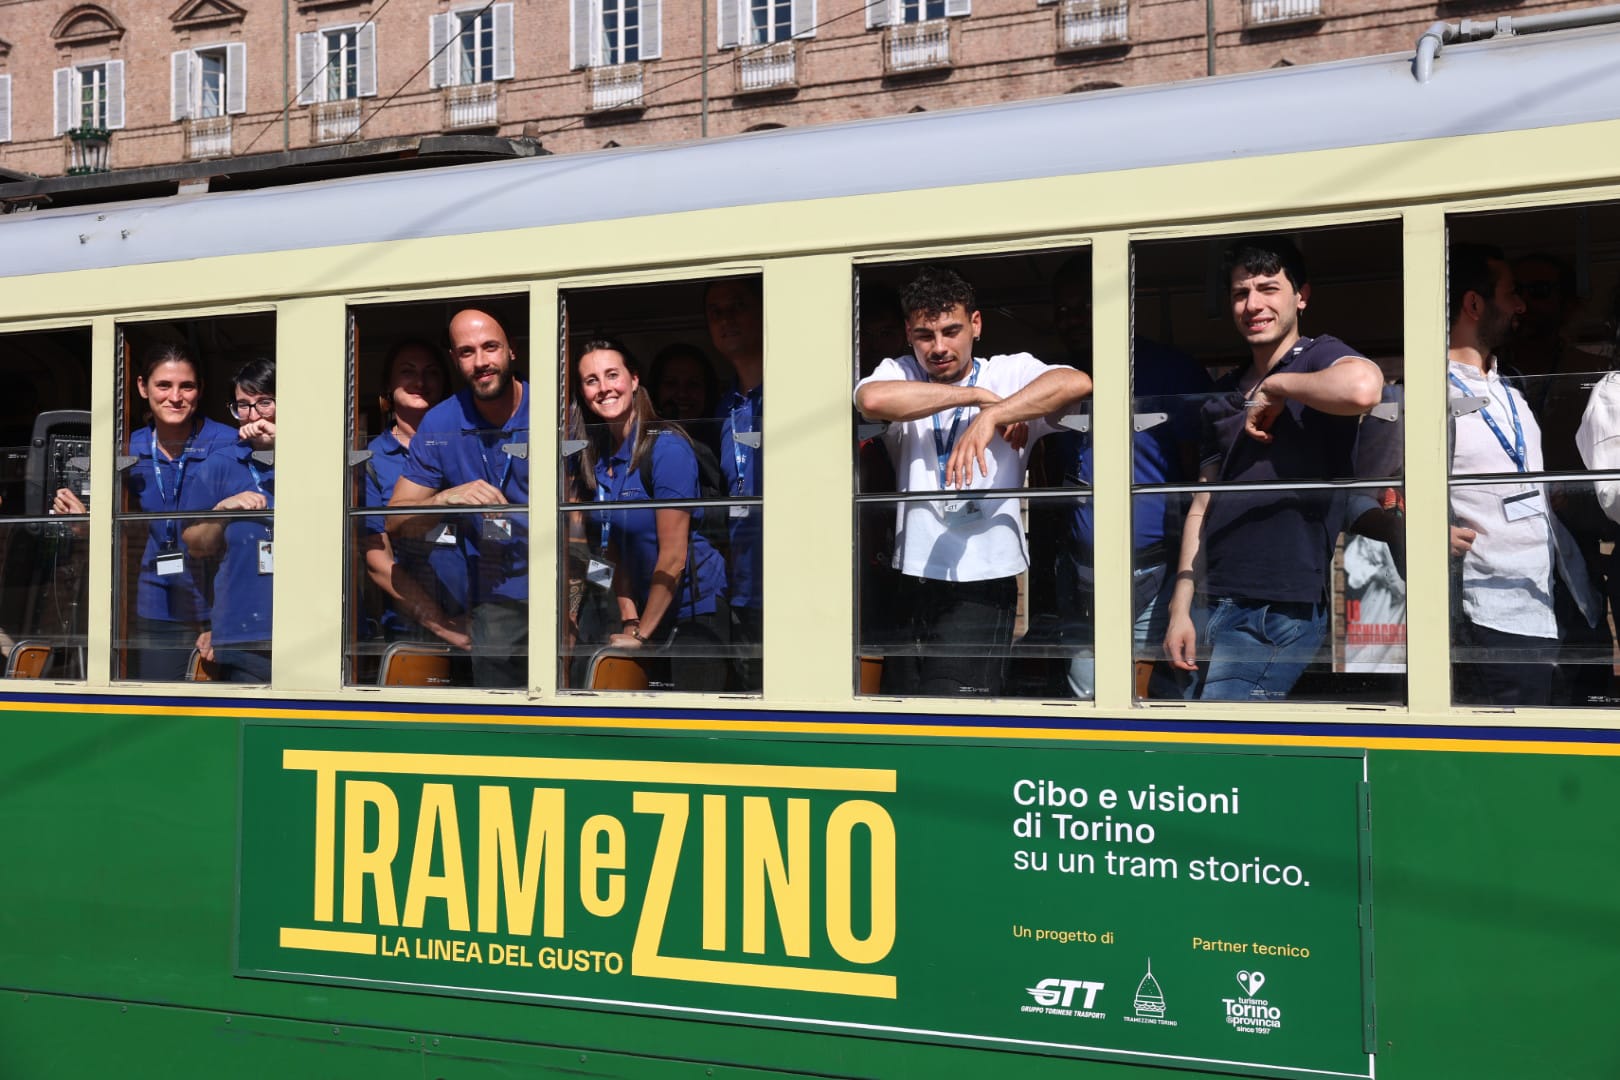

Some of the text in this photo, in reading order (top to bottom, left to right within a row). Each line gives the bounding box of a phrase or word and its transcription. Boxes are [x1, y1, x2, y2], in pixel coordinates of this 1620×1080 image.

[1013, 779, 1239, 815] Cibo e visioni
[1013, 811, 1155, 844] di Torino
[1013, 850, 1310, 887] su un tram storico.
[1013, 925, 1115, 945] Un progetto di
[381, 935, 624, 975] LA LINEA DEL GUSTO
[1192, 937, 1310, 958] Partner tecnico
[1025, 977, 1105, 1010] GTT
[1238, 996, 1269, 1006] turismo
[1021, 1005, 1107, 1020] GRUPPO TORINESE TRASPORTI
[1222, 998, 1281, 1020] Torino
[1236, 1025, 1272, 1035] since 1997
